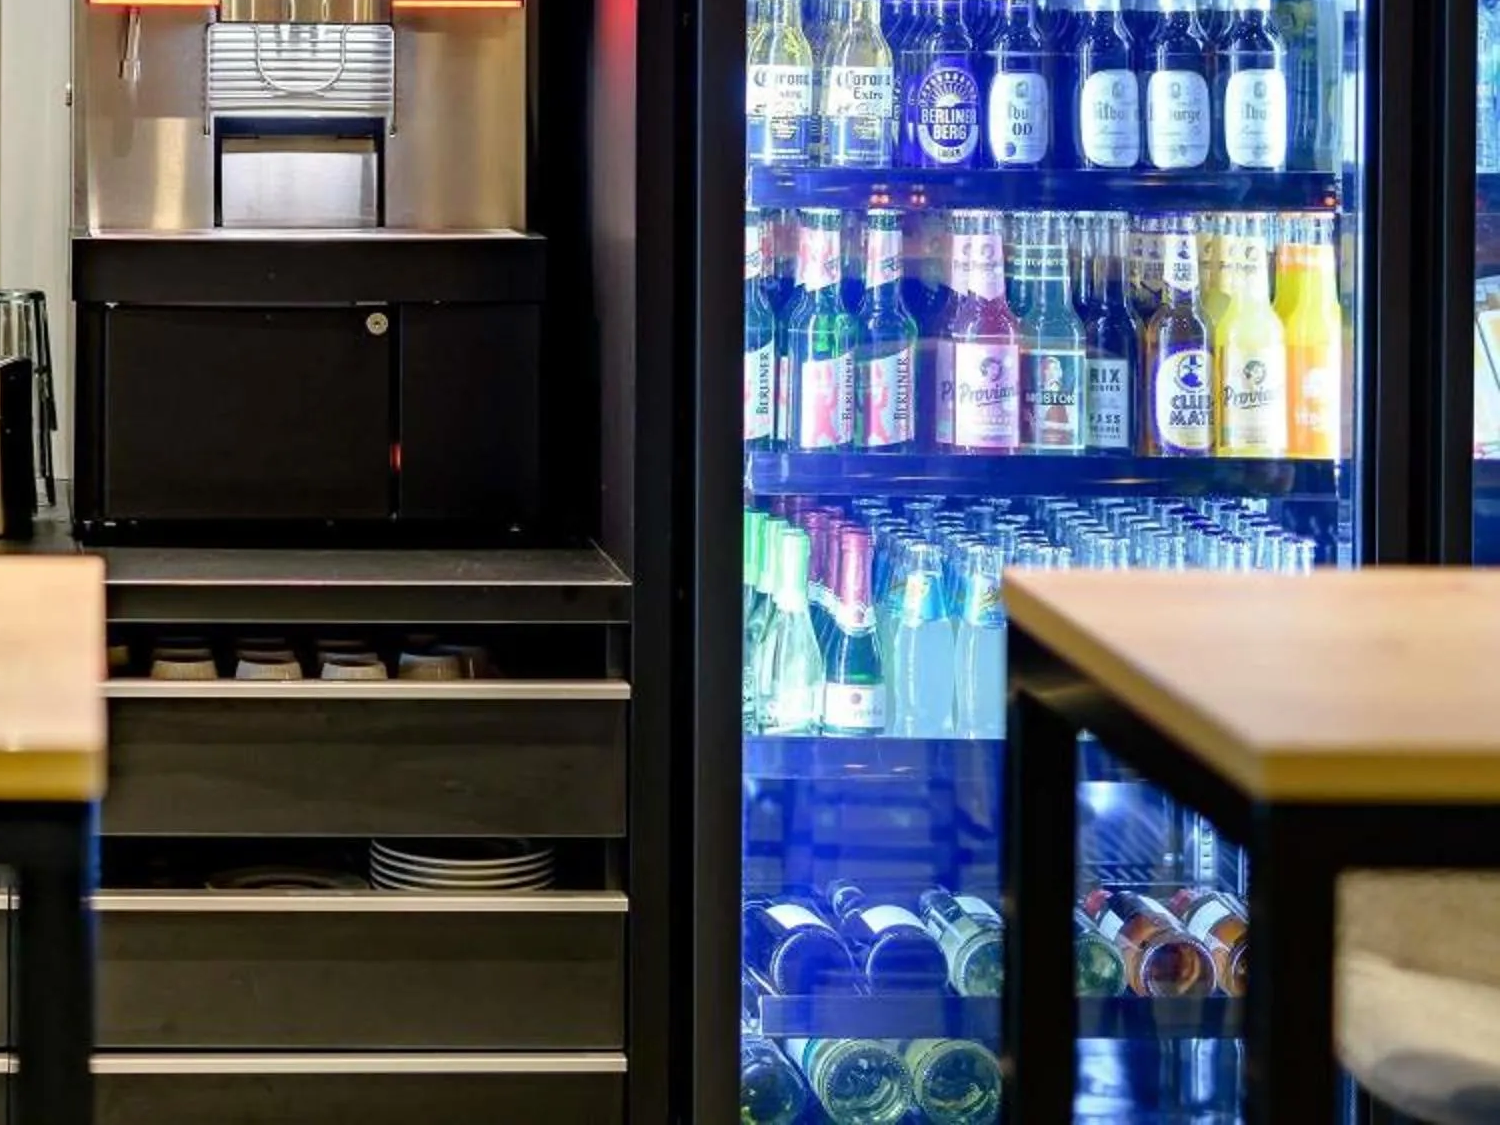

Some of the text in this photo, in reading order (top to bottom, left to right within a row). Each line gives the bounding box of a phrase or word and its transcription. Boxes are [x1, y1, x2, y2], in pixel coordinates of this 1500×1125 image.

[753, 70, 810, 88] Crona
[921, 107, 977, 125] BERLINER
[932, 124, 967, 140] BERG
[756, 352, 770, 415] BERLINER
[959, 380, 1016, 405] Provian
